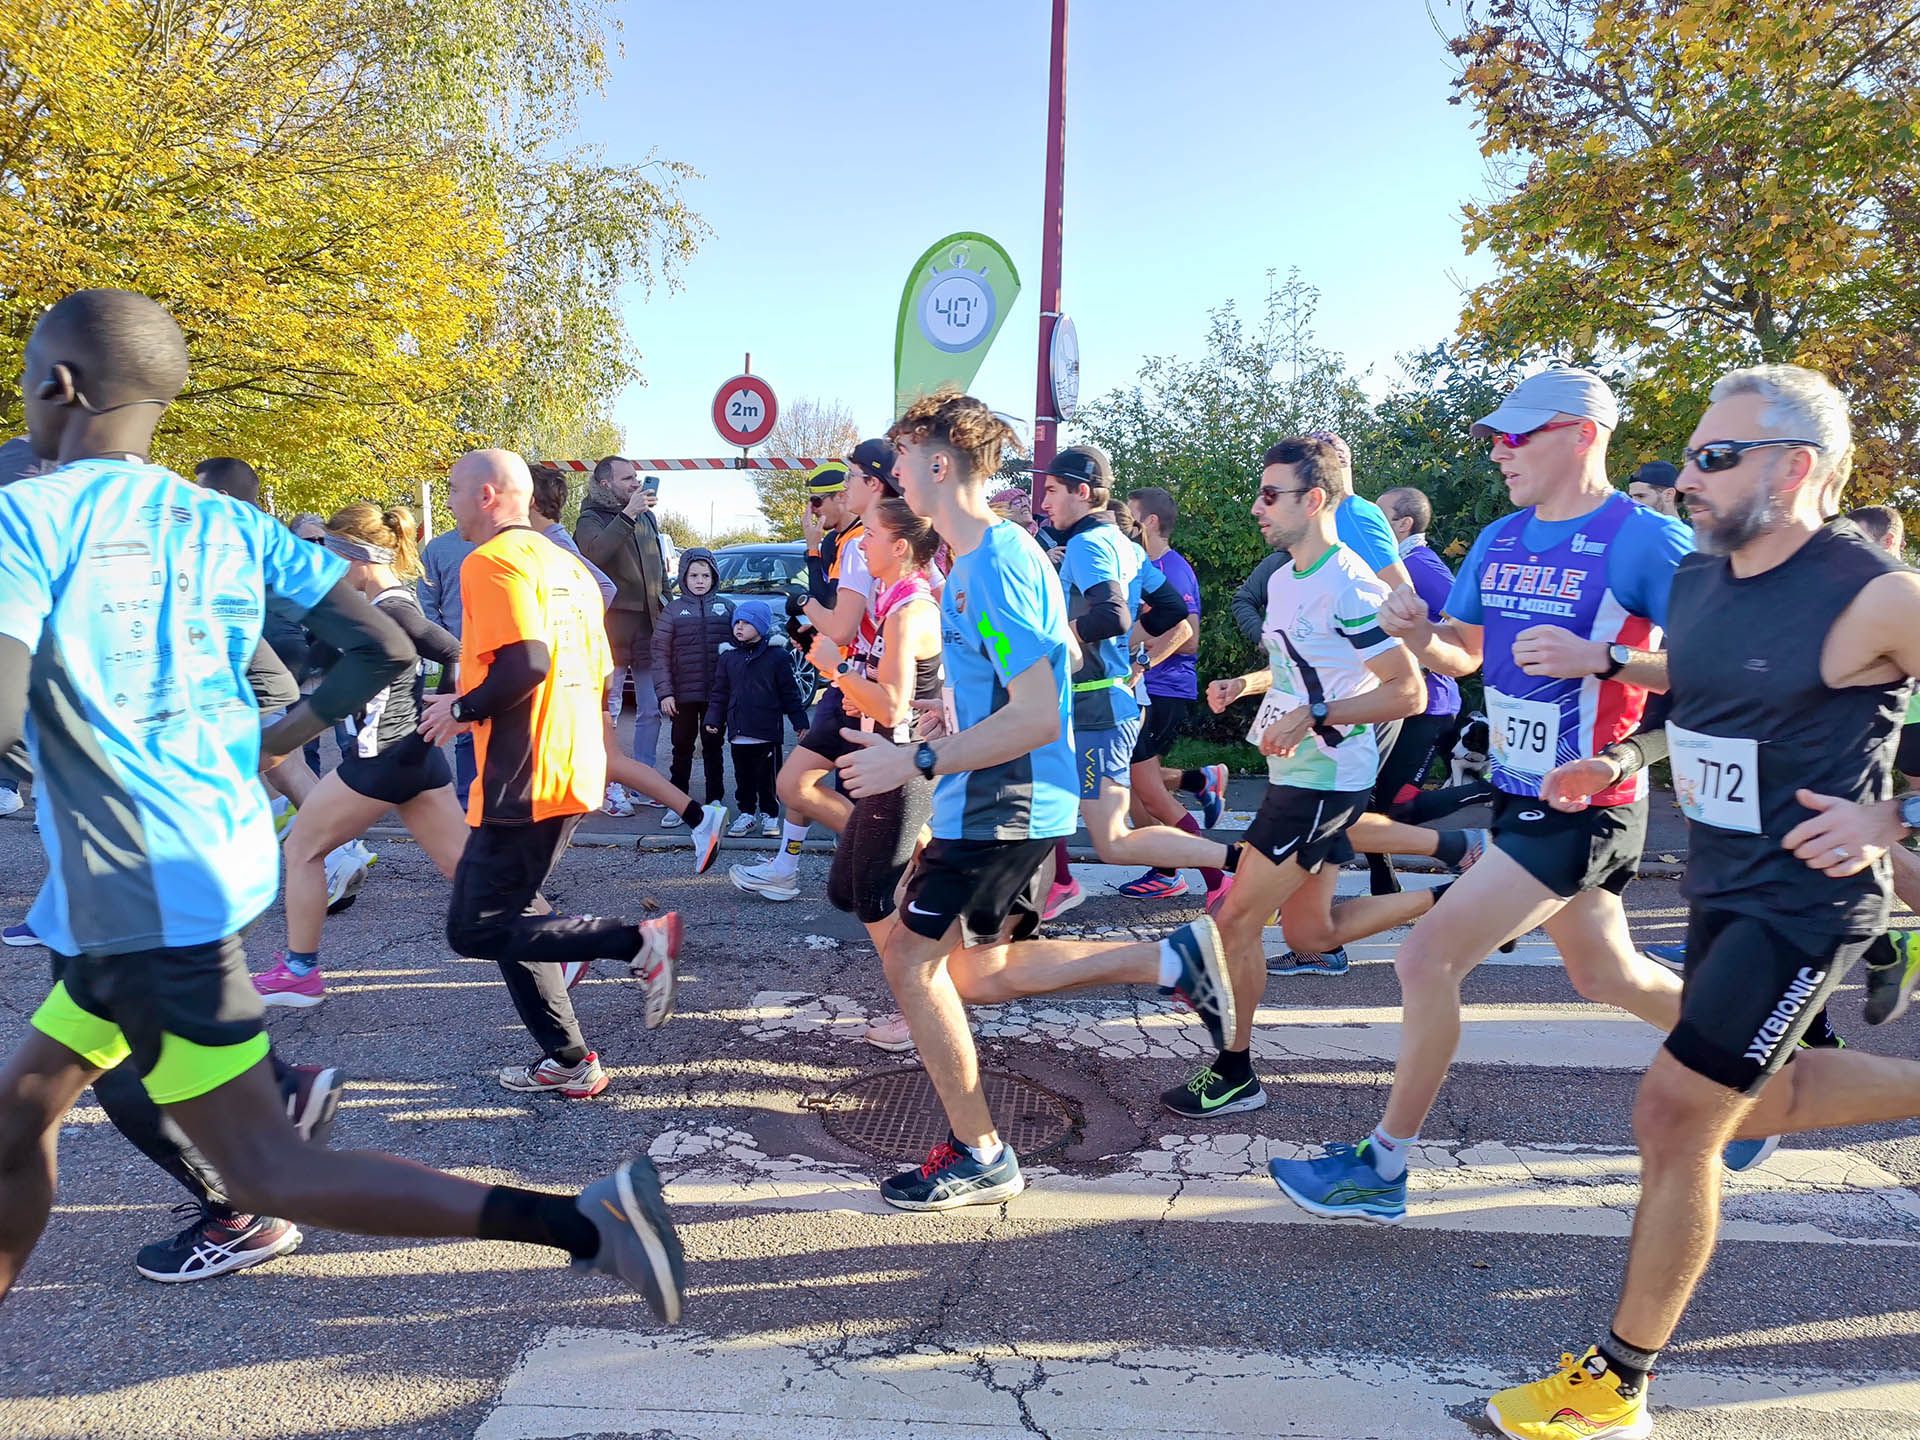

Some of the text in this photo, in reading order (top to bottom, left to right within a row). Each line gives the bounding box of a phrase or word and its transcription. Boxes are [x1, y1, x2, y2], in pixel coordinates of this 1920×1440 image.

[731, 401, 759, 417] 2m
[1480, 562, 1588, 601] ATHLE
[1260, 704, 1288, 729] 85
[1506, 716, 1546, 753] 579
[1697, 758, 1745, 803] 772
